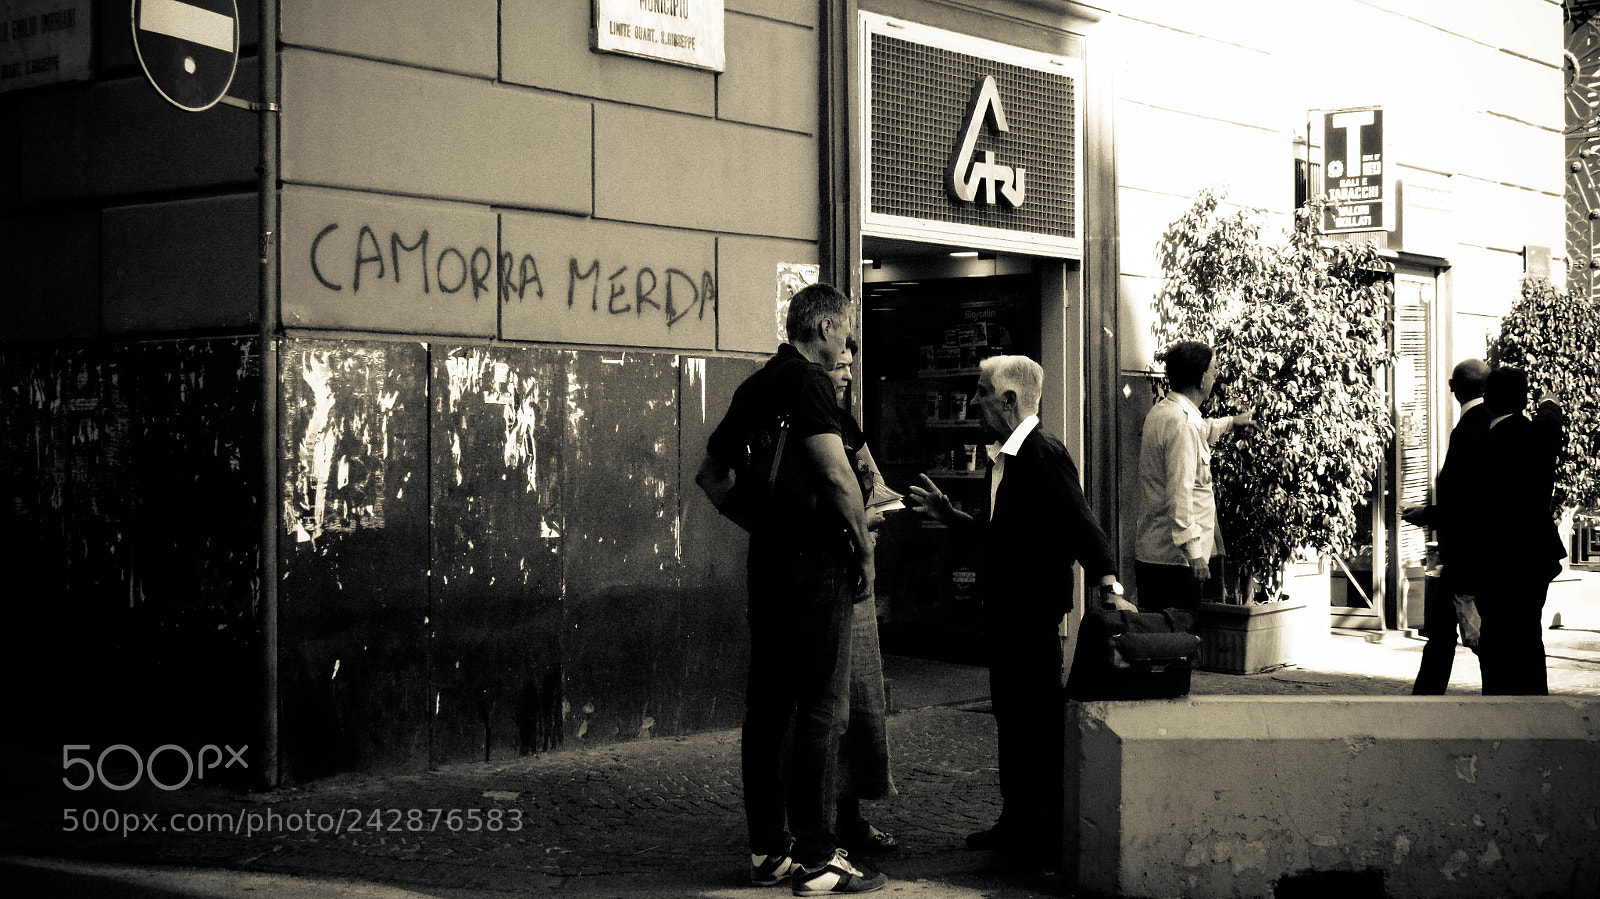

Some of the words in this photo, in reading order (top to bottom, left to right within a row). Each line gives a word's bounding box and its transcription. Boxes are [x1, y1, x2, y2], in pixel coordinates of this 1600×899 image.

[609, 20, 631, 38] LIMITE
[1332, 110, 1375, 178] T
[1328, 185, 1379, 201] TABACCHI
[310, 223, 544, 303] CAMORRA
[568, 257, 717, 327] MERDA
